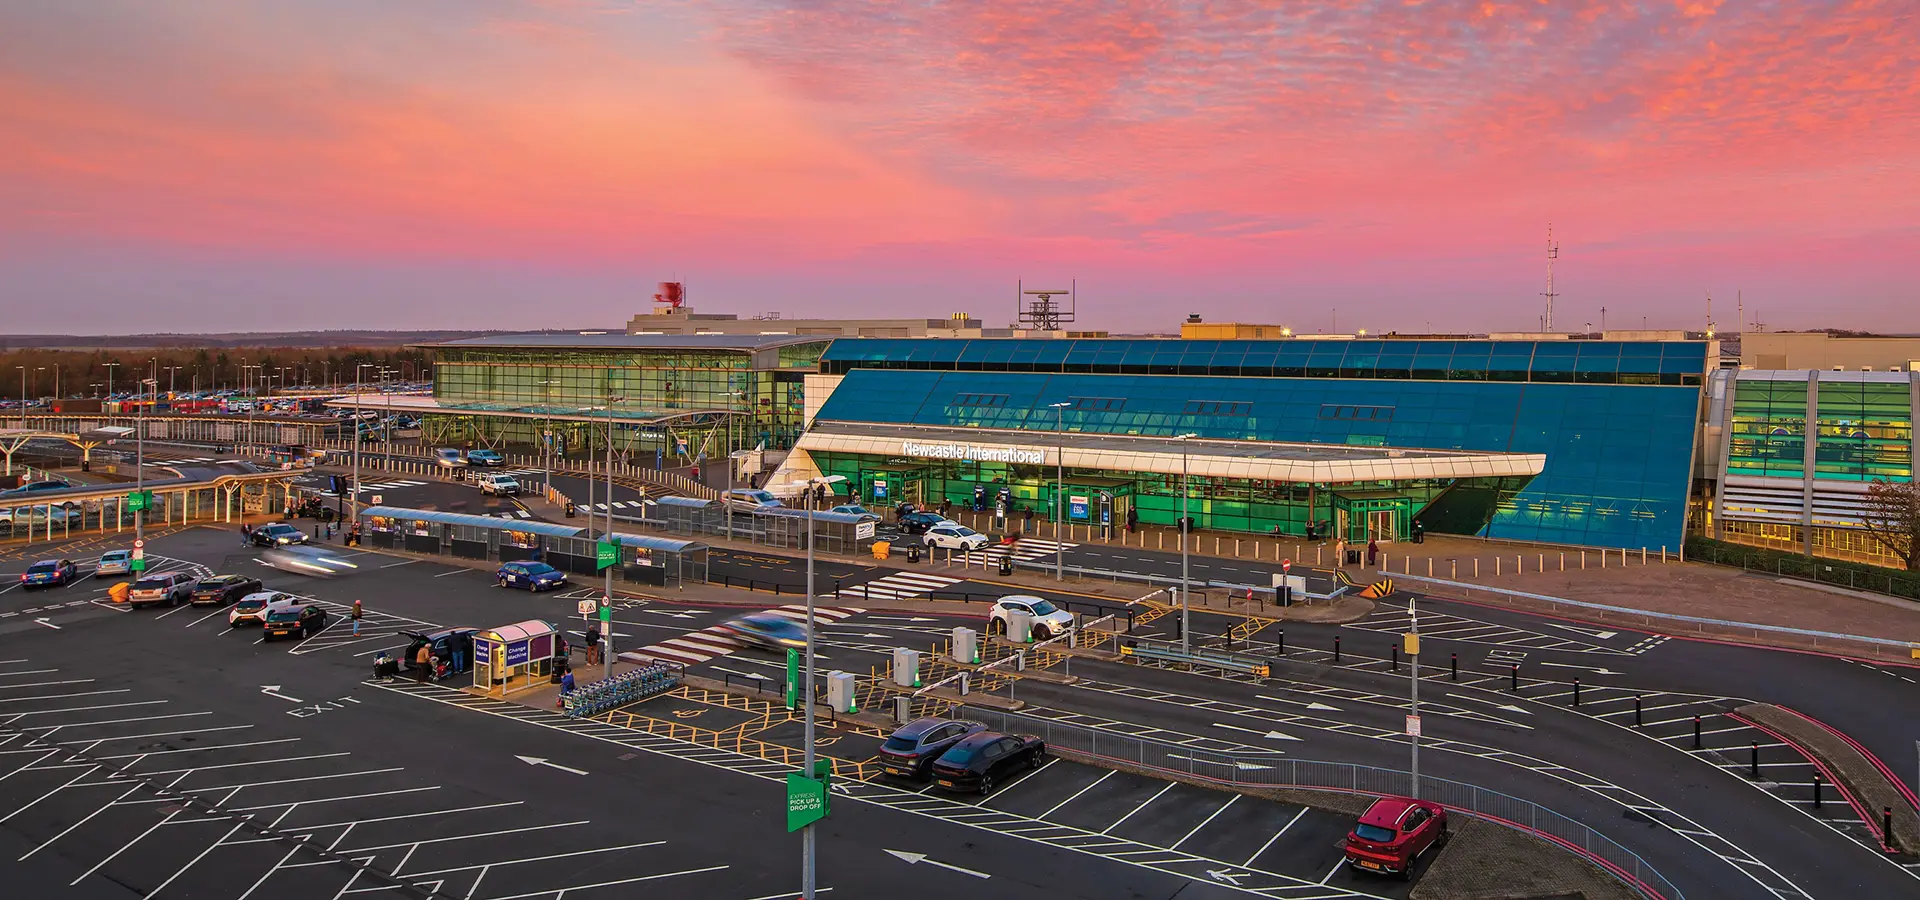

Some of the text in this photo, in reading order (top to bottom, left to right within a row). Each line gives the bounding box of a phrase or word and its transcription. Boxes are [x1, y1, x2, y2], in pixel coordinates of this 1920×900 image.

[903, 442, 1045, 464] Newcastle International
[507, 652, 527, 660] Machine
[508, 646, 526, 654] Change
[285, 695, 362, 718] EXIT
